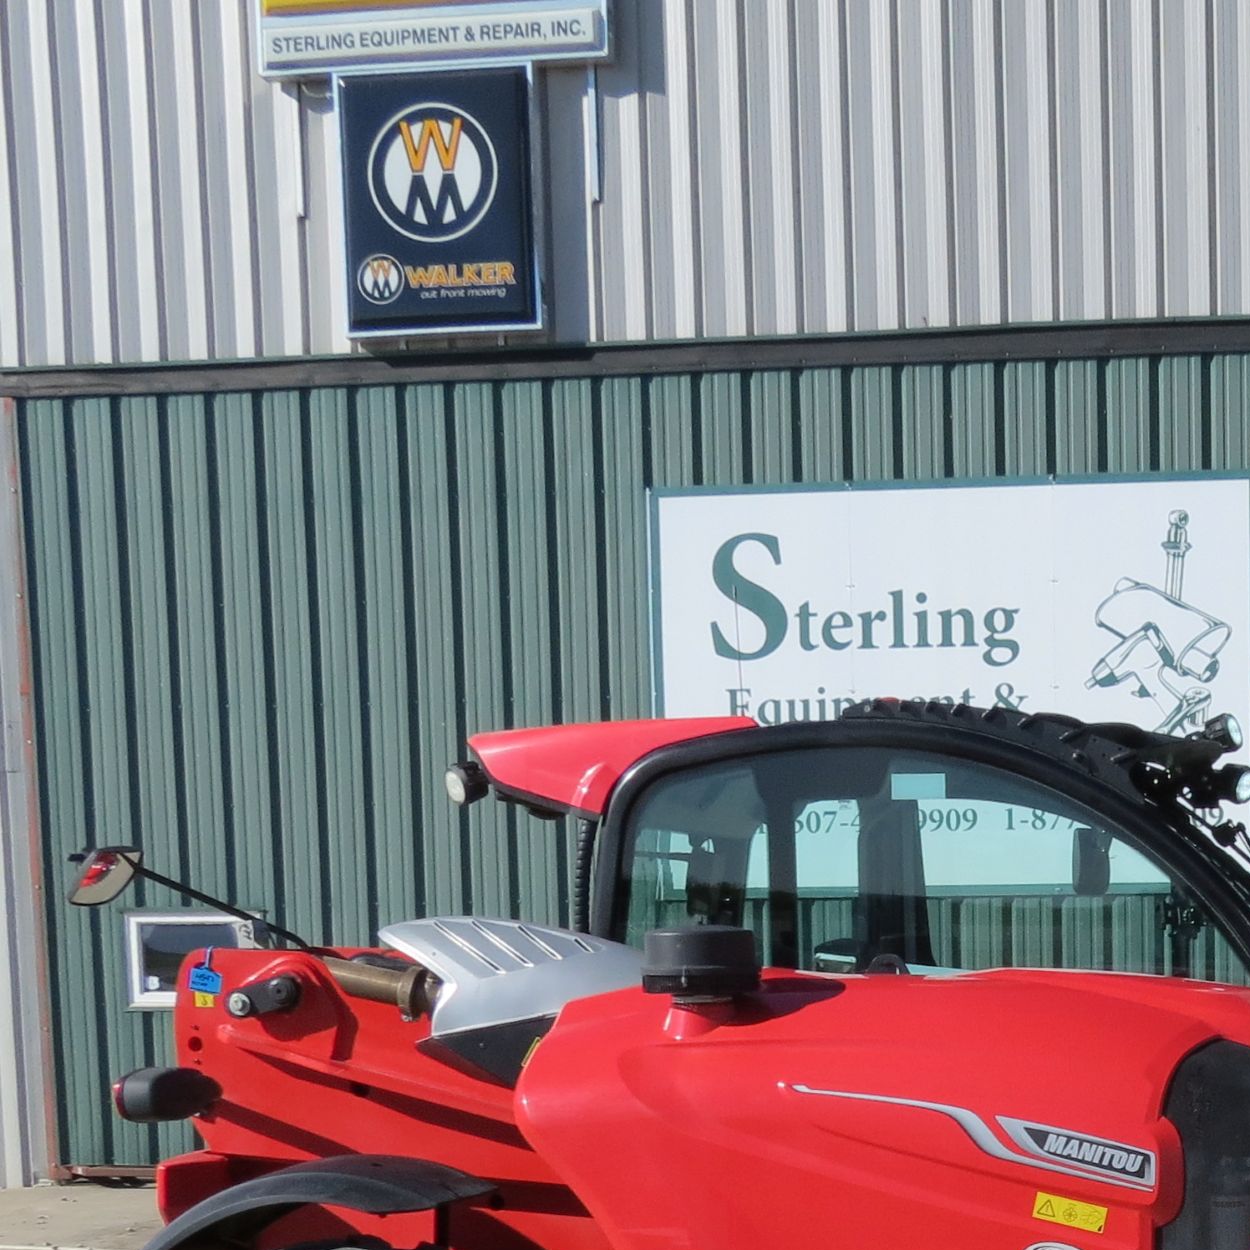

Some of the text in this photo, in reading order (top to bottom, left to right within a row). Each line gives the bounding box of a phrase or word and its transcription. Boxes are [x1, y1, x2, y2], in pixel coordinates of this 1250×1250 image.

[272, 19, 586, 54] STERLING EQUIPMENT & REPAIR, INC.
[404, 261, 517, 288] WALKER
[420, 287, 507, 300] out front mowing
[710, 531, 1021, 667] Sterling
[725, 685, 976, 726] Equit
[1043, 1132, 1144, 1174] MANITOU
